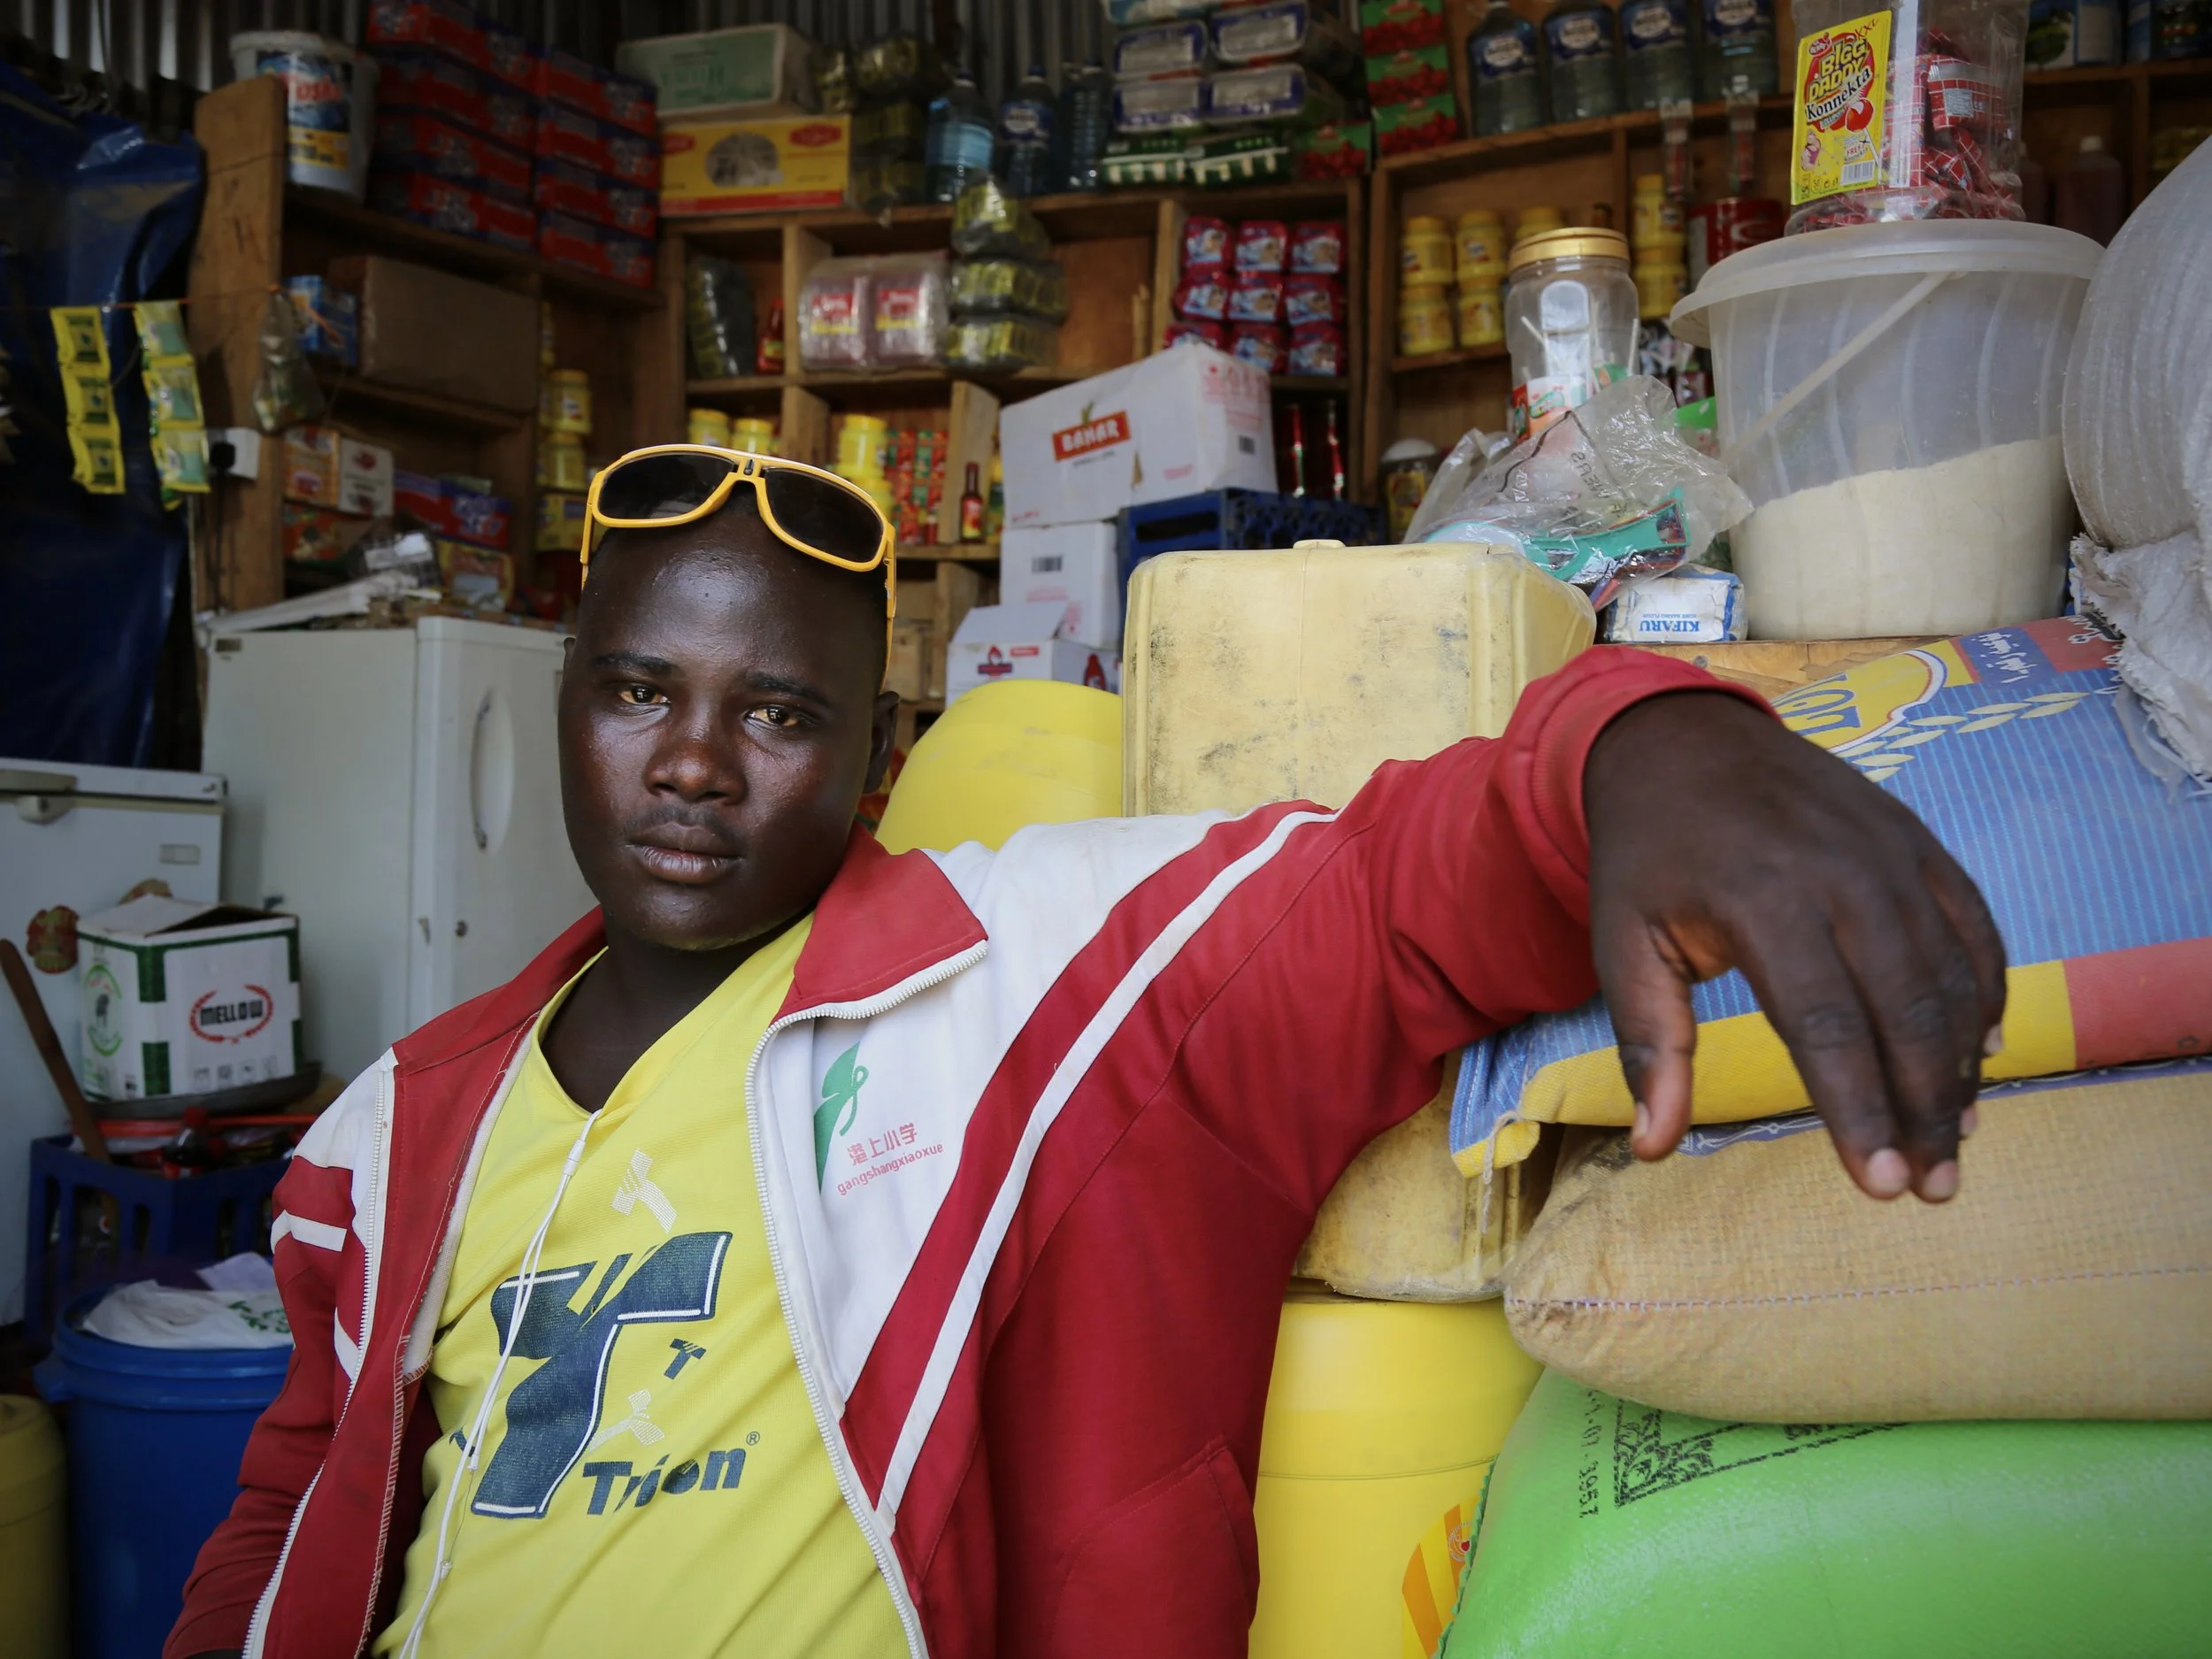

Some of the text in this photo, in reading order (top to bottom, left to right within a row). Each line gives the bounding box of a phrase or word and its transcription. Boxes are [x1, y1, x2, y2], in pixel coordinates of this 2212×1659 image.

[1805, 67, 1871, 120] Konnekta
[1807, 57, 1864, 104] DADDY
[1639, 620, 1701, 633] KIFARU
[199, 1000, 264, 1026] MELLOW
[847, 1122, 918, 1166] 港上小学
[837, 1143, 944, 1195] gangshangxiaoxue
